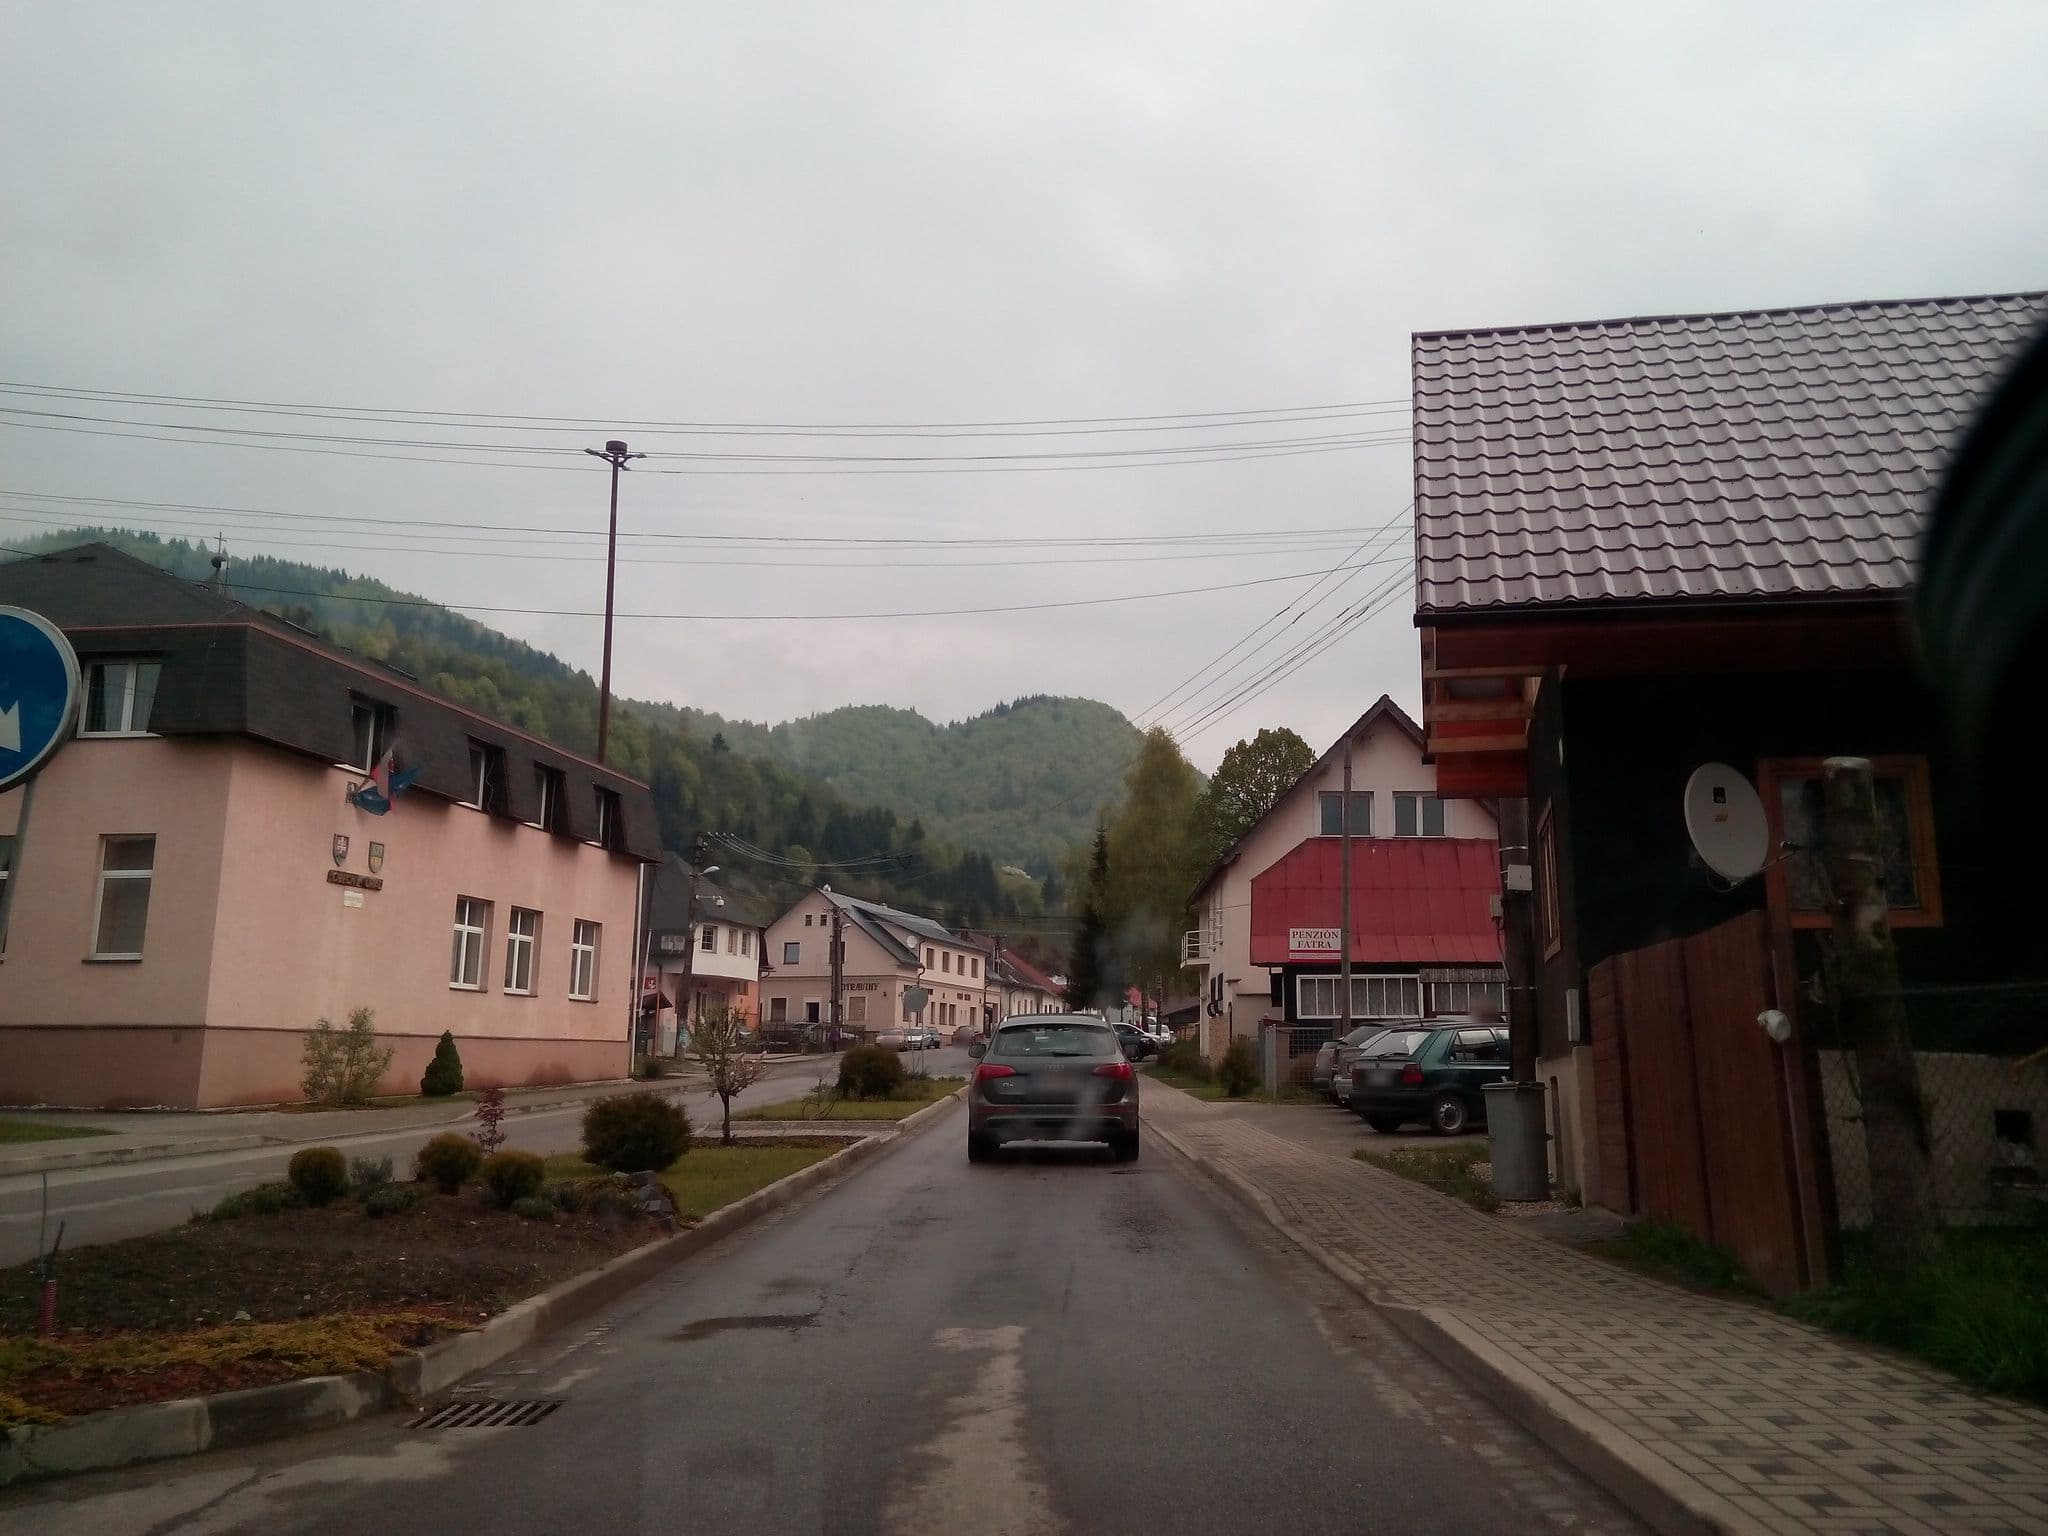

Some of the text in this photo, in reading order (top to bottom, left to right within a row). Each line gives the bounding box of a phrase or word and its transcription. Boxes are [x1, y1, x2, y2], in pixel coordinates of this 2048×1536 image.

[1292, 930, 1339, 939] PENZIÓN
[1298, 940, 1332, 948] FATRA
[841, 982, 880, 991] OTRAVINY
